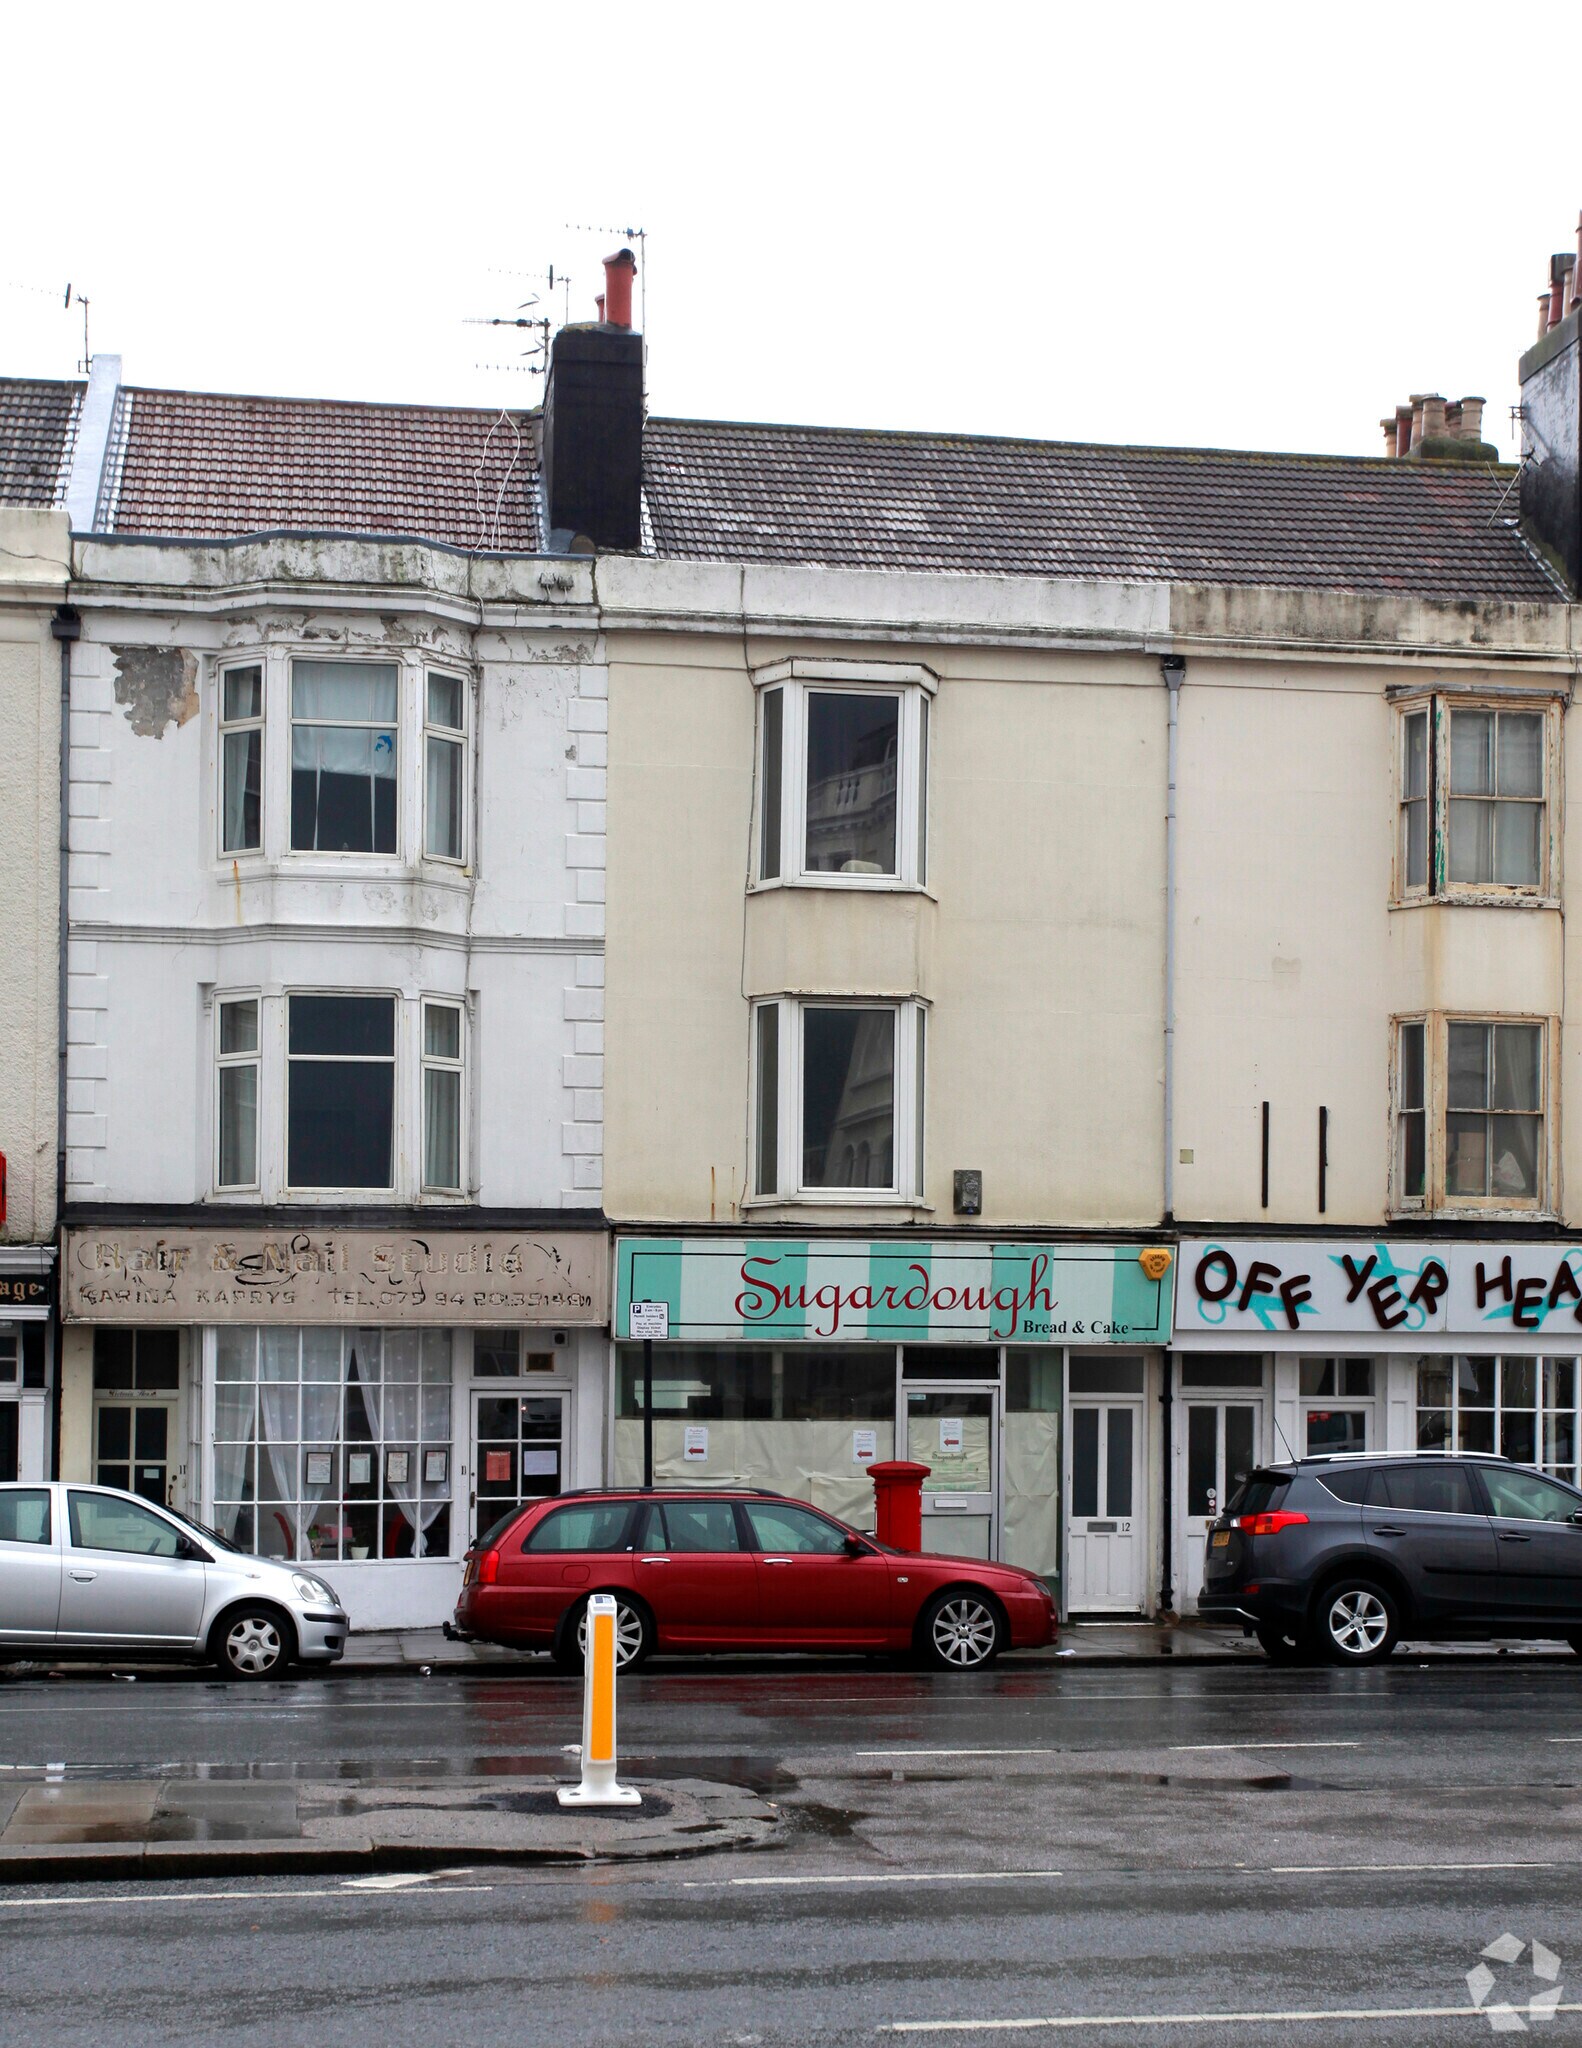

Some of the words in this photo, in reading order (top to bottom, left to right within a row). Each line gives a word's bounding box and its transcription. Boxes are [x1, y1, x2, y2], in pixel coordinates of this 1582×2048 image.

[96, 1239, 191, 1272] Hair
[212, 1242, 241, 1272] &
[261, 1241, 351, 1273] Nail
[373, 1243, 523, 1273] Studio
[734, 1253, 1059, 1338] Sugardough
[1195, 1250, 1312, 1330] OFF
[1342, 1254, 1449, 1329] YER
[1475, 1256, 1582, 1328] HEA
[1023, 1319, 1058, 1334] Bread
[1072, 1320, 1085, 1334] &
[1091, 1320, 1129, 1335] Cake
[1121, 1522, 1131, 1532] 12
